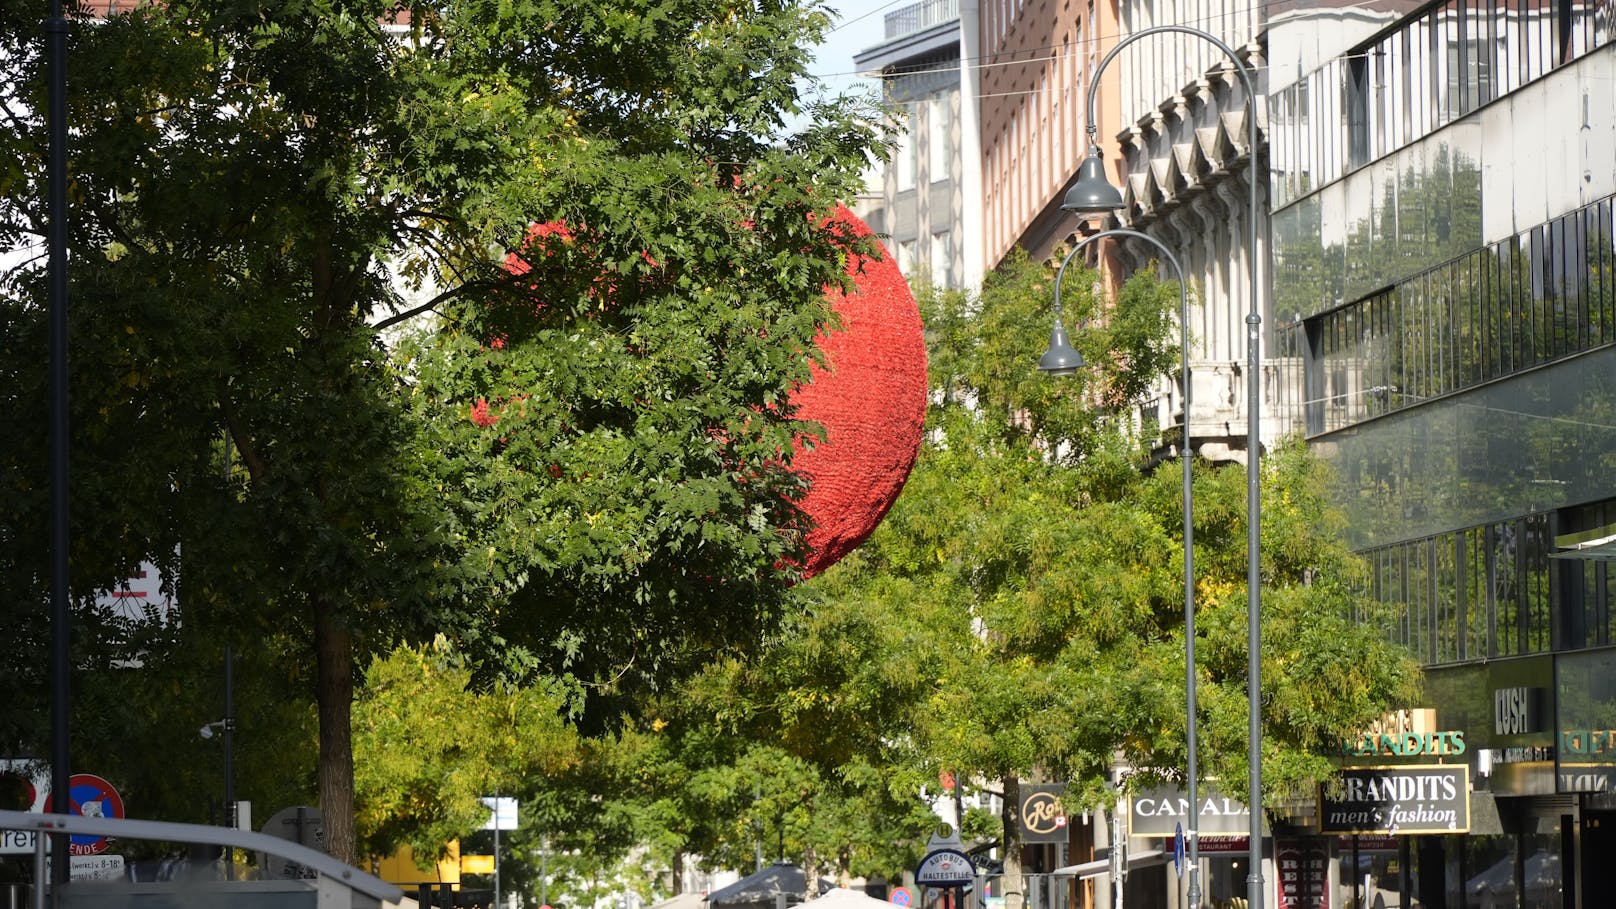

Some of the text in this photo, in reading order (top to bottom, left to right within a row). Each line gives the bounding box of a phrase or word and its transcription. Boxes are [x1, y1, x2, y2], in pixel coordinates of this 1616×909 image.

[1495, 687, 1528, 735] LUSH
[1385, 804, 1457, 828] fashion
[929, 854, 964, 867] AUTOBUS
[923, 872, 970, 880] HALTESTELLE
